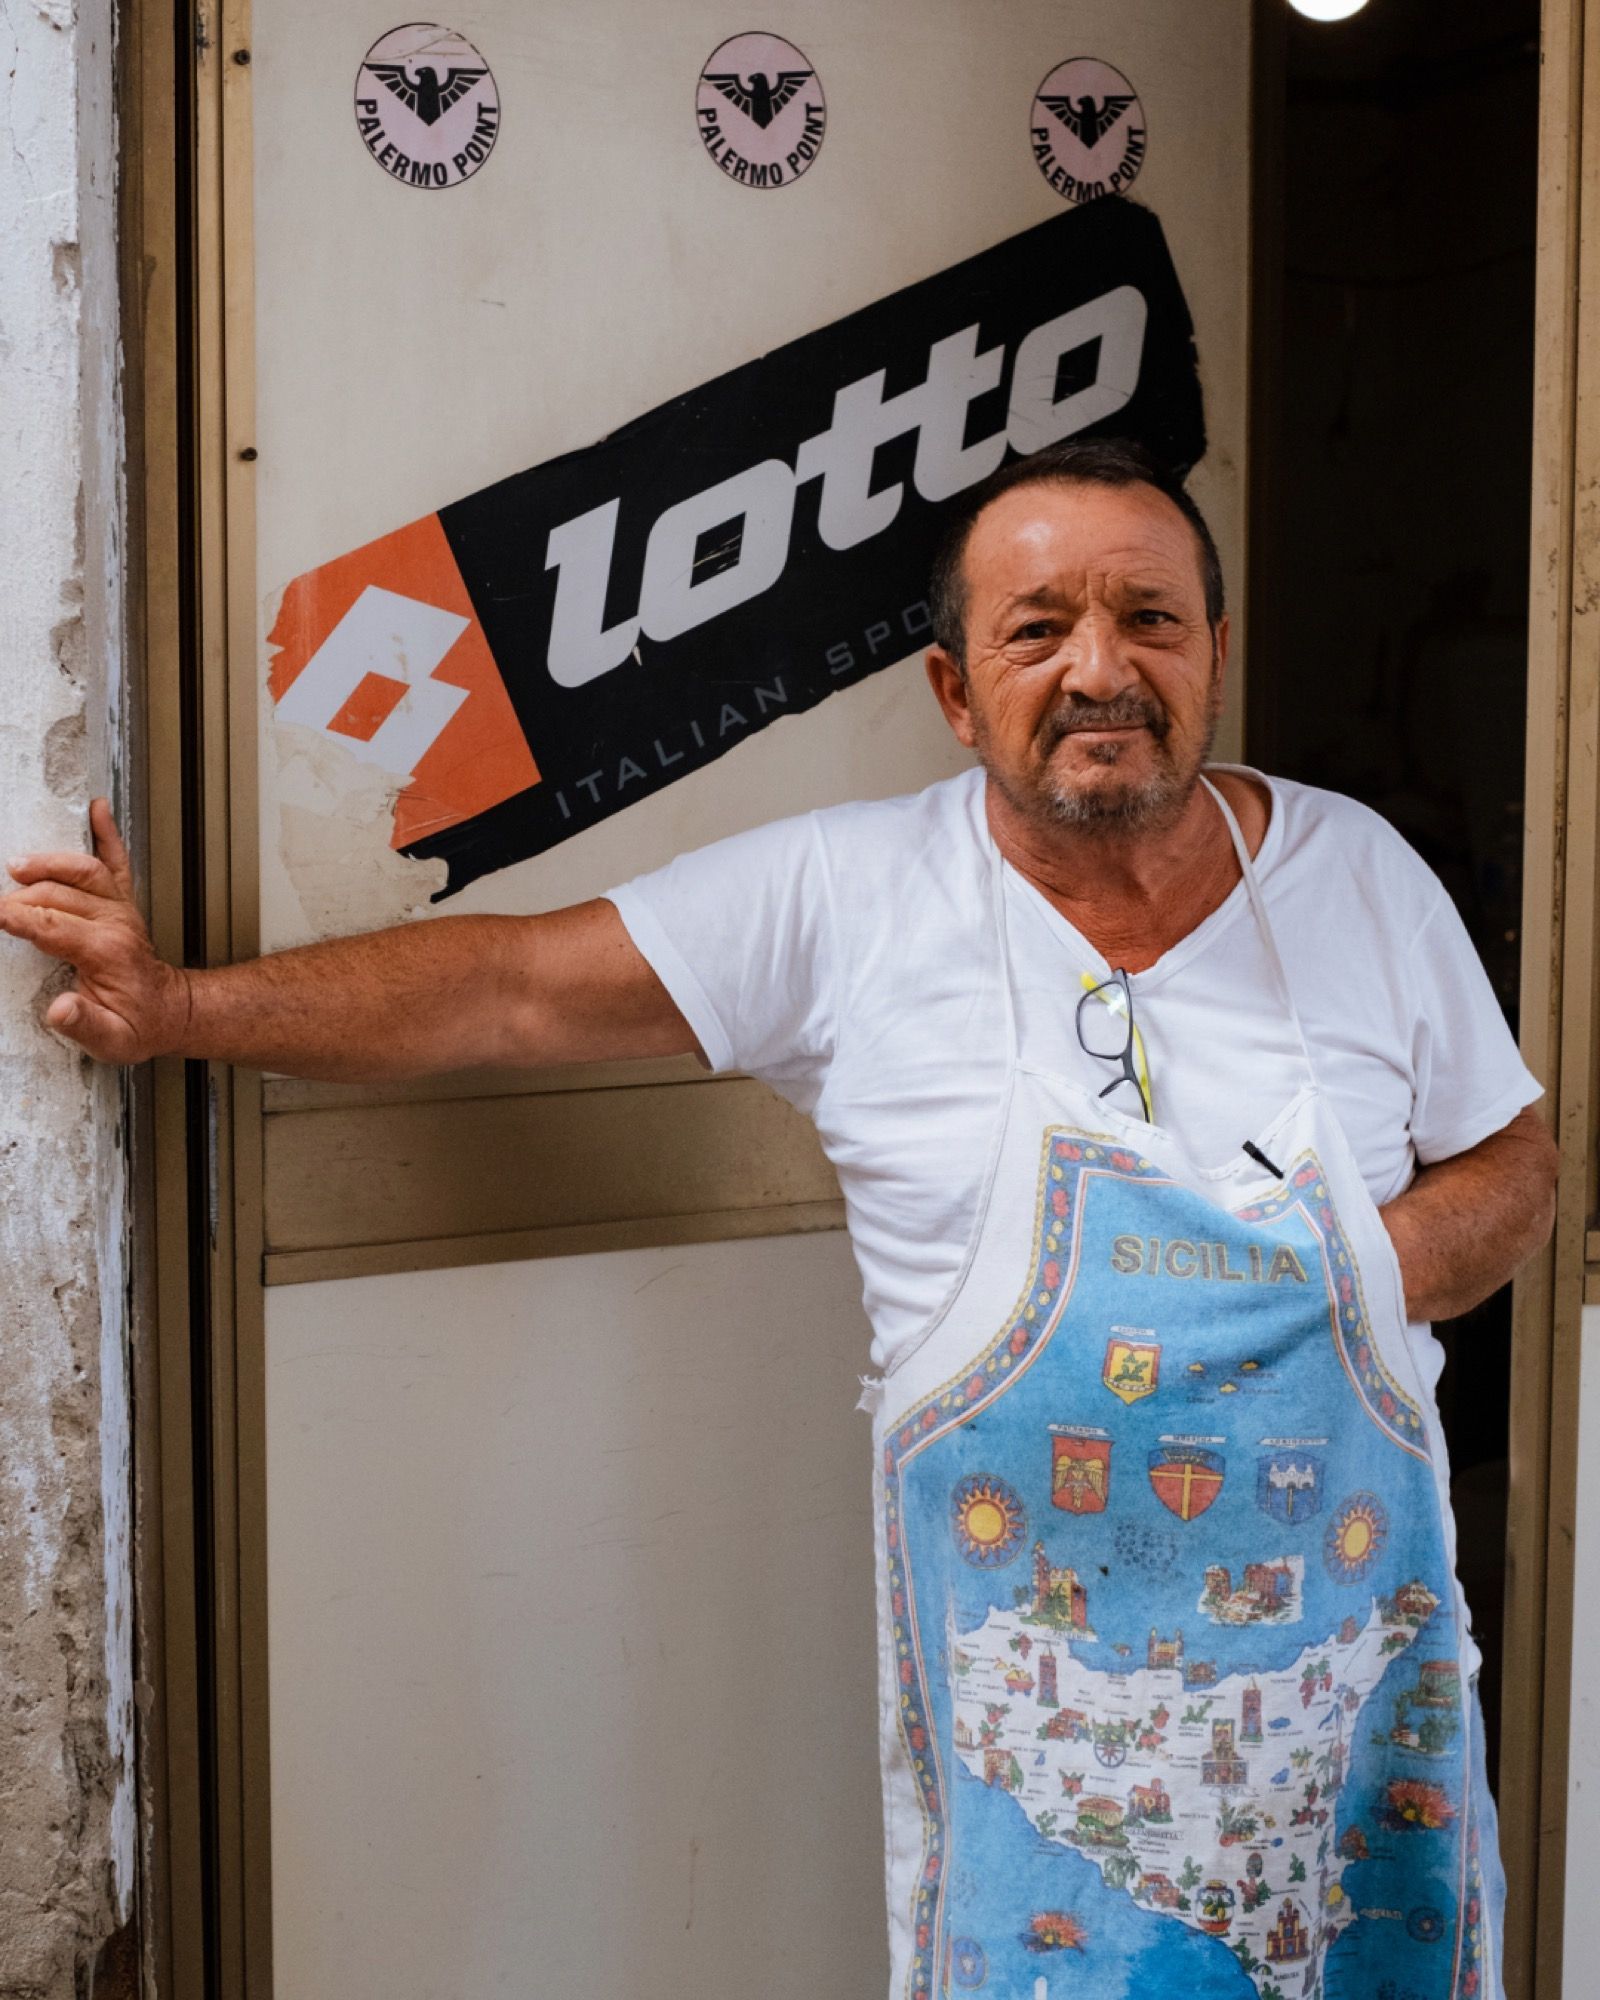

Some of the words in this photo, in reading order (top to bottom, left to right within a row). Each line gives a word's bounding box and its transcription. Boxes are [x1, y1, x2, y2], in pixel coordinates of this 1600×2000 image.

[356, 99, 448, 186] PALERMO
[452, 101, 497, 177] POINT
[697, 108, 783, 186] PALERMO
[786, 102, 824, 175] POINT
[1031, 127, 1106, 201] PALERMO
[1109, 125, 1144, 193] POINT
[544, 285, 1148, 688] lotto
[555, 676, 788, 819] ITALIAN
[825, 600, 933, 676] SPO
[1110, 1234, 1308, 1283] SICILIA
